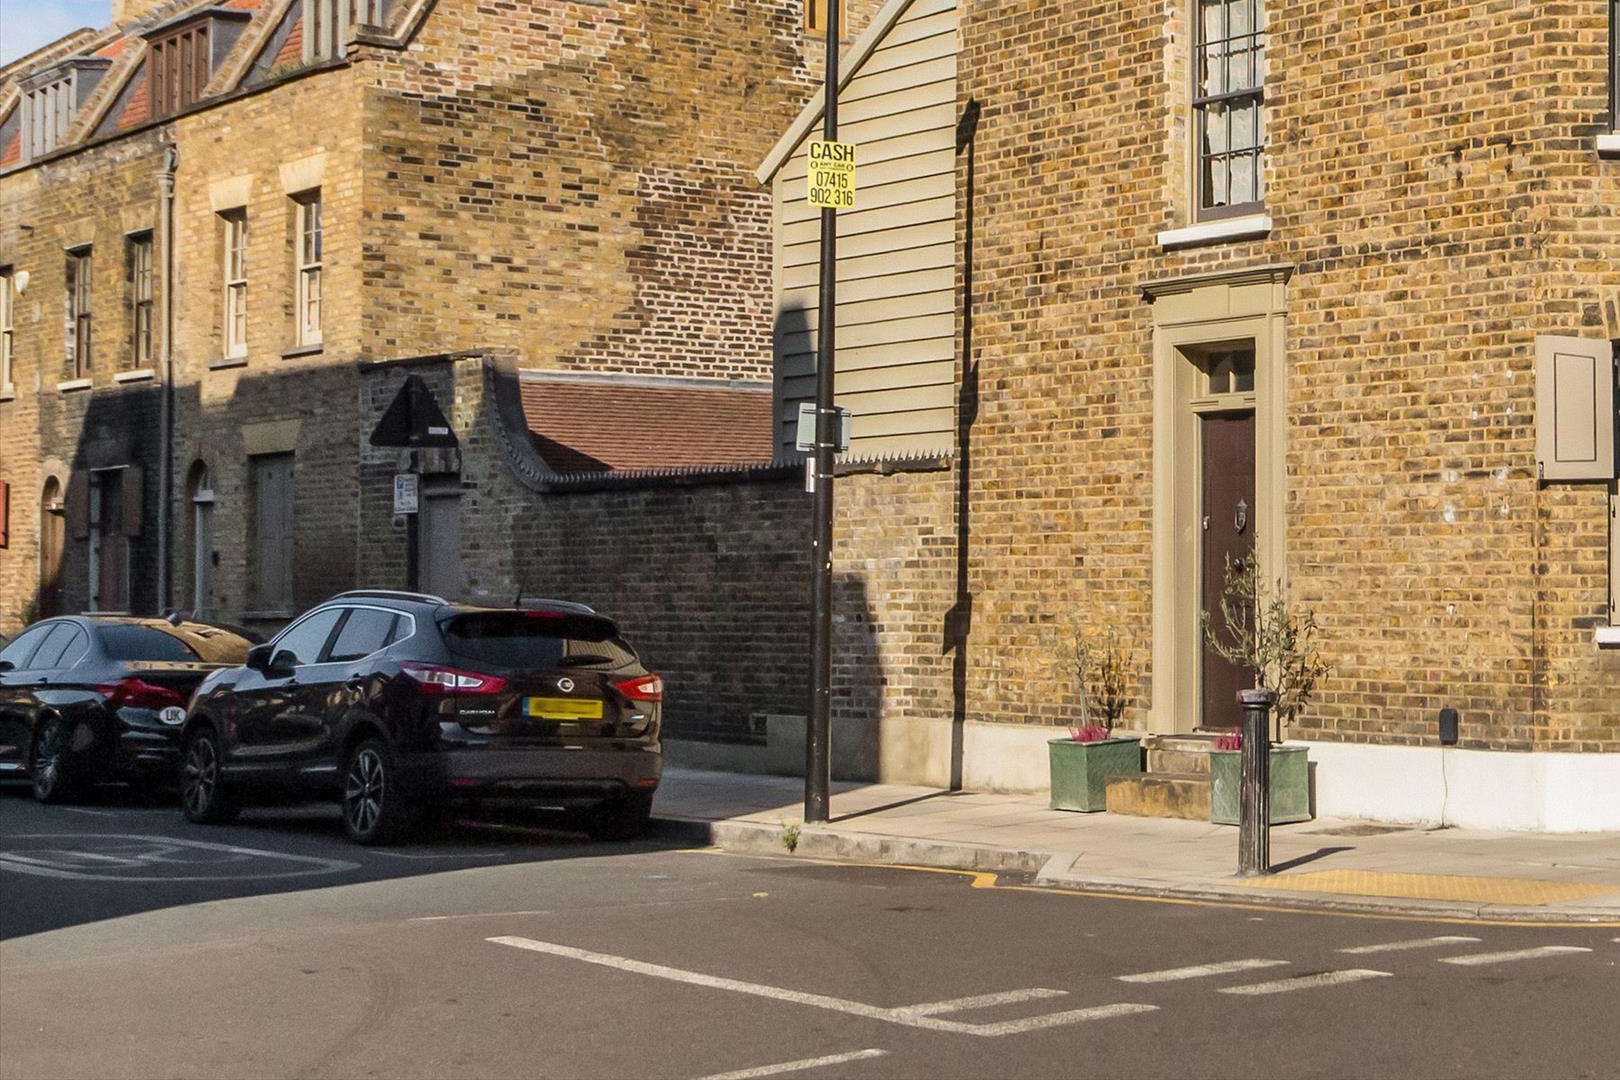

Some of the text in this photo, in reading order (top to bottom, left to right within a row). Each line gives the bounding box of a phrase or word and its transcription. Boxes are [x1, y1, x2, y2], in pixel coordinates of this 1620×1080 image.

[810, 142, 854, 162] CASH
[816, 171, 848, 189] 07415
[810, 188, 854, 207] 902 316
[166, 709, 181, 721] UK
